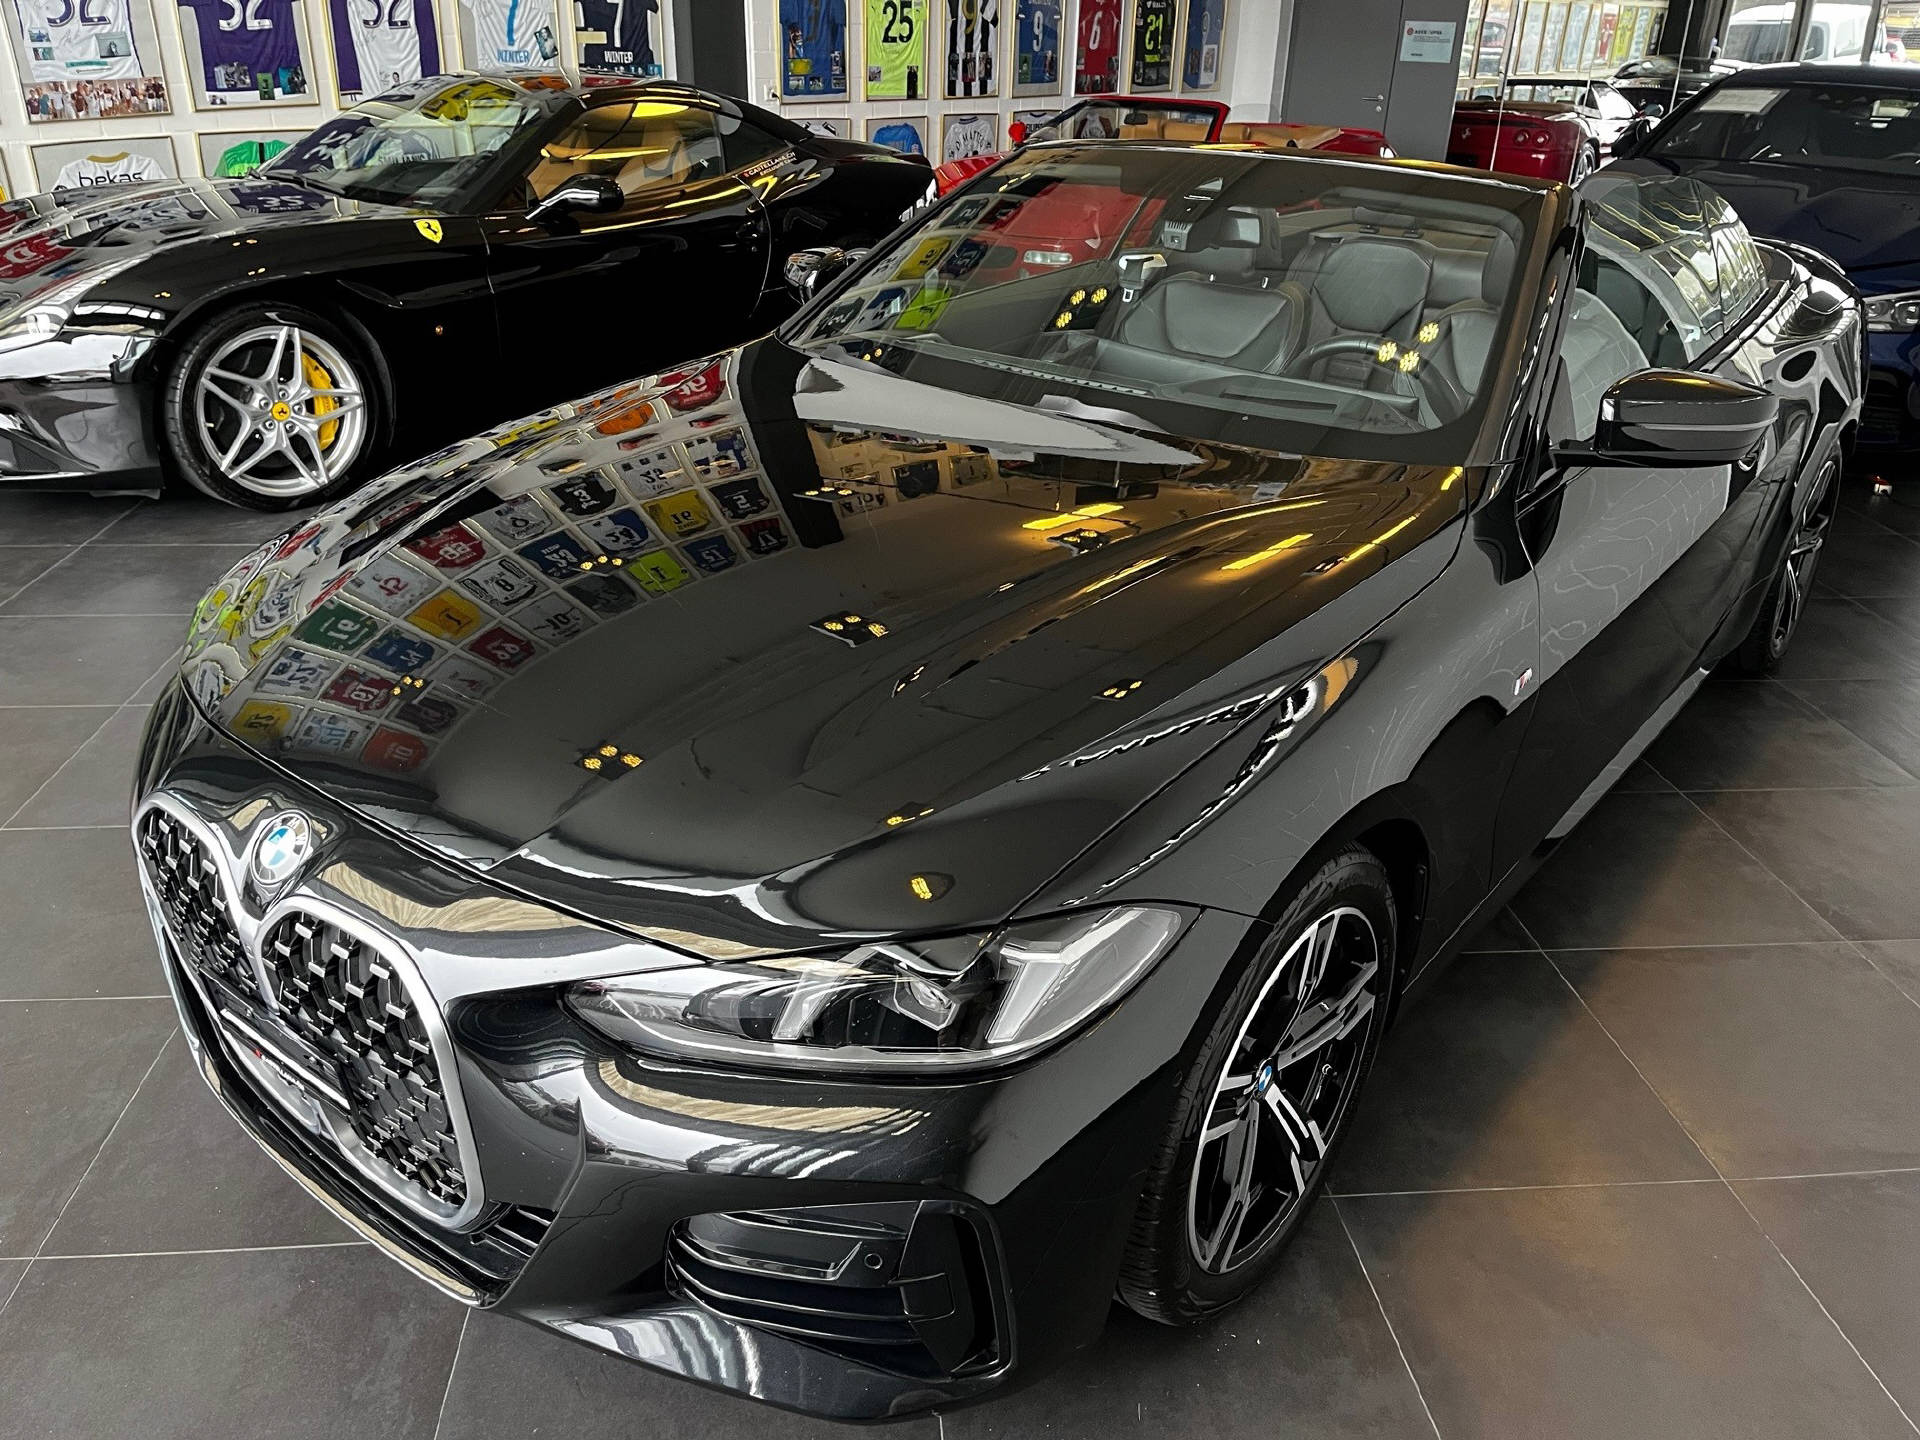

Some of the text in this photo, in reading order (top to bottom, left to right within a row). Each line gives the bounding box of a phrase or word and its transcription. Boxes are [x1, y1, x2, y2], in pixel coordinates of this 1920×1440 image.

[882, 0, 914, 43] 25
[1032, 10, 1043, 52] 9
[1089, 10, 1103, 50] 6
[1145, 14, 1164, 50] 21
[497, 49, 530, 63] WINTER
[604, 51, 634, 63] WINTER
